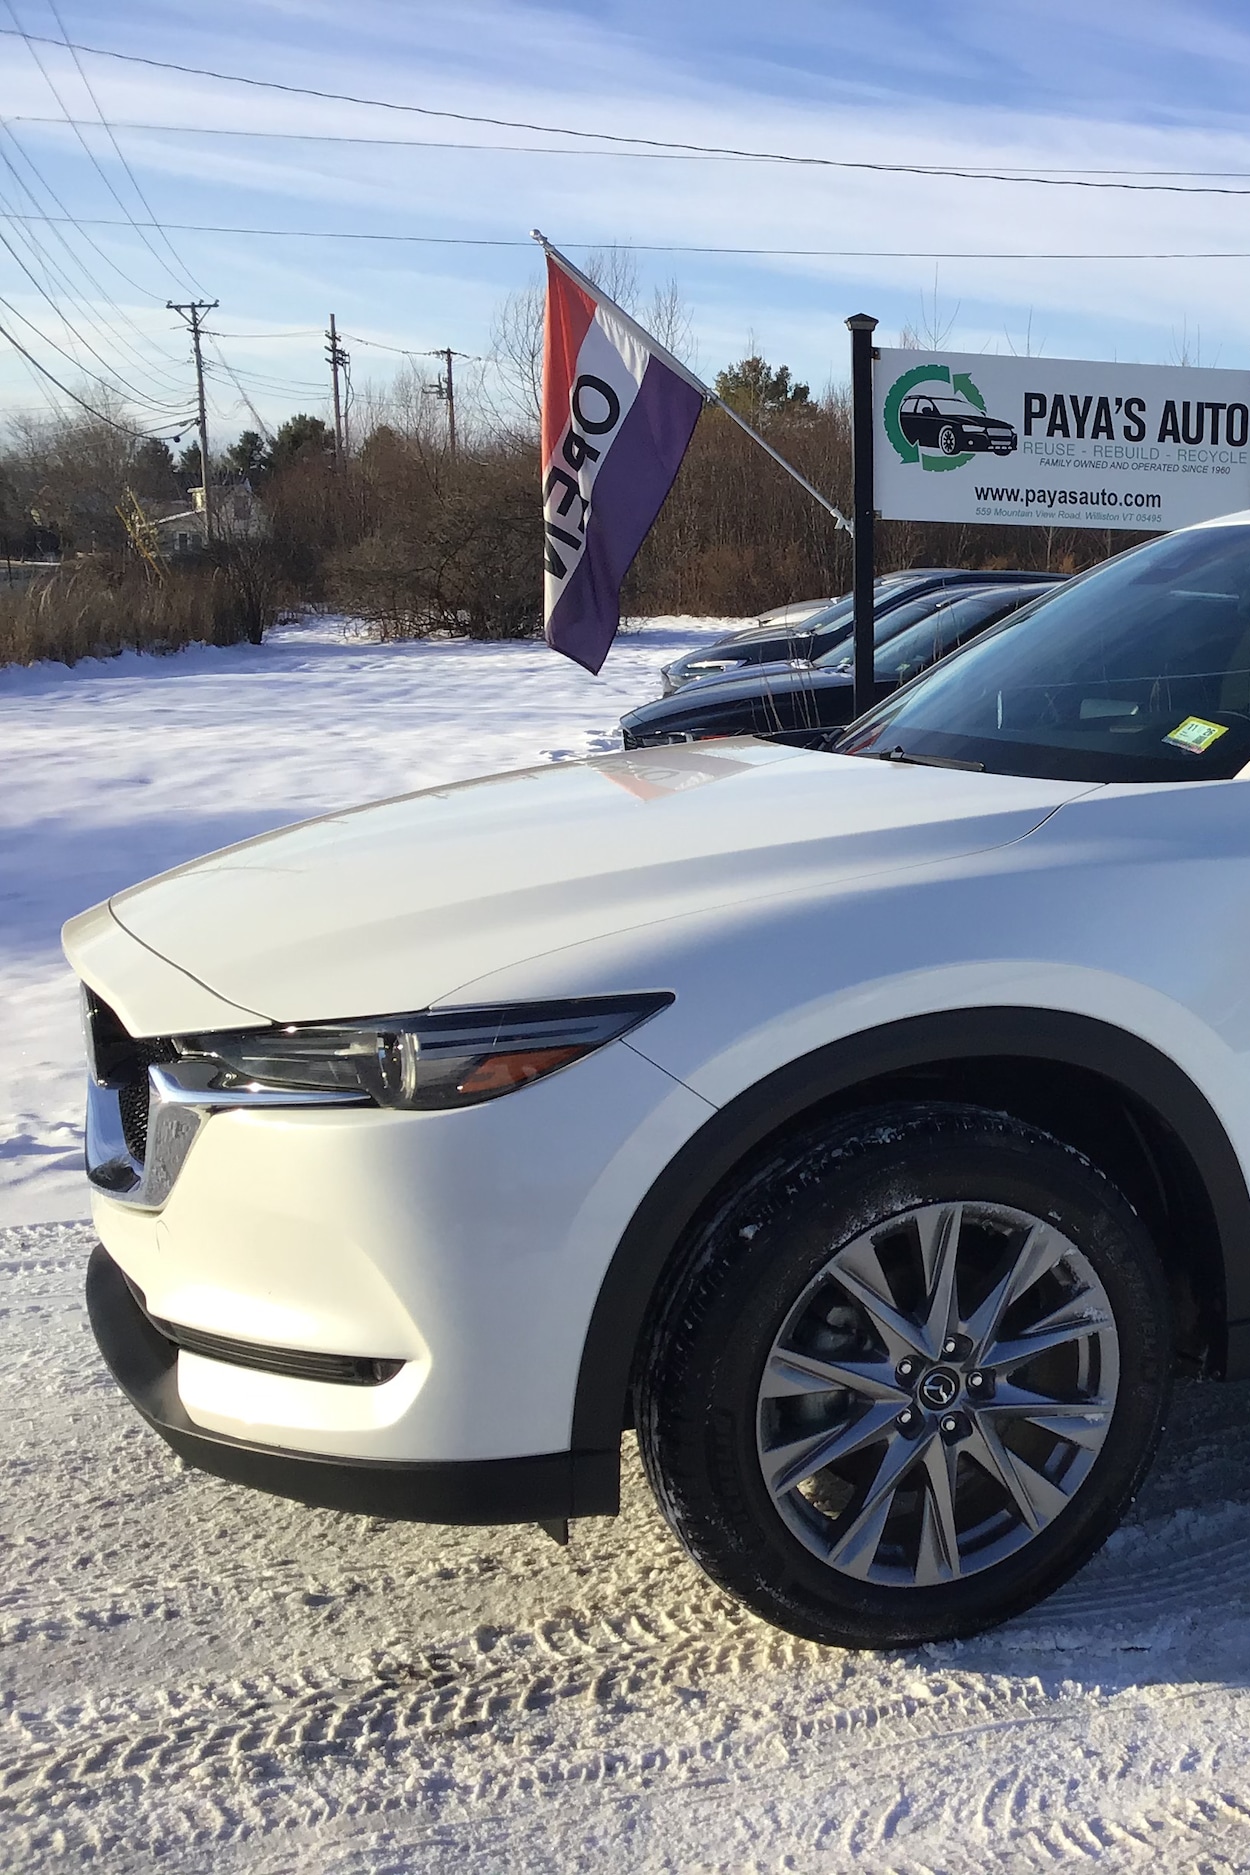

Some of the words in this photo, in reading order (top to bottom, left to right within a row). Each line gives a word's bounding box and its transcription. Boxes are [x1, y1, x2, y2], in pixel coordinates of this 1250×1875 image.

[1023, 392, 1146, 442] PAYA'S
[1157, 400, 1249, 447] AUTO
[1023, 441, 1076, 457] REUSE
[1093, 445, 1160, 460] REBUILD
[1177, 448, 1248, 465] RECYCLE
[1039, 457, 1072, 468] FAMILY
[1073, 459, 1108, 470] OWNED
[1109, 461, 1130, 470] AND
[1131, 462, 1180, 473] OPERATED
[1181, 464, 1209, 475] SINCE
[1211, 466, 1231, 476] 1960
[974, 486, 1162, 508] www.payasauto.com
[975, 506, 992, 516] 559
[993, 508, 1033, 518] Mountain
[1035, 509, 1056, 519] View
[1085, 511, 1120, 521] Williston
[1122, 513, 1135, 521] VT
[1135, 513, 1162, 523] 05495
